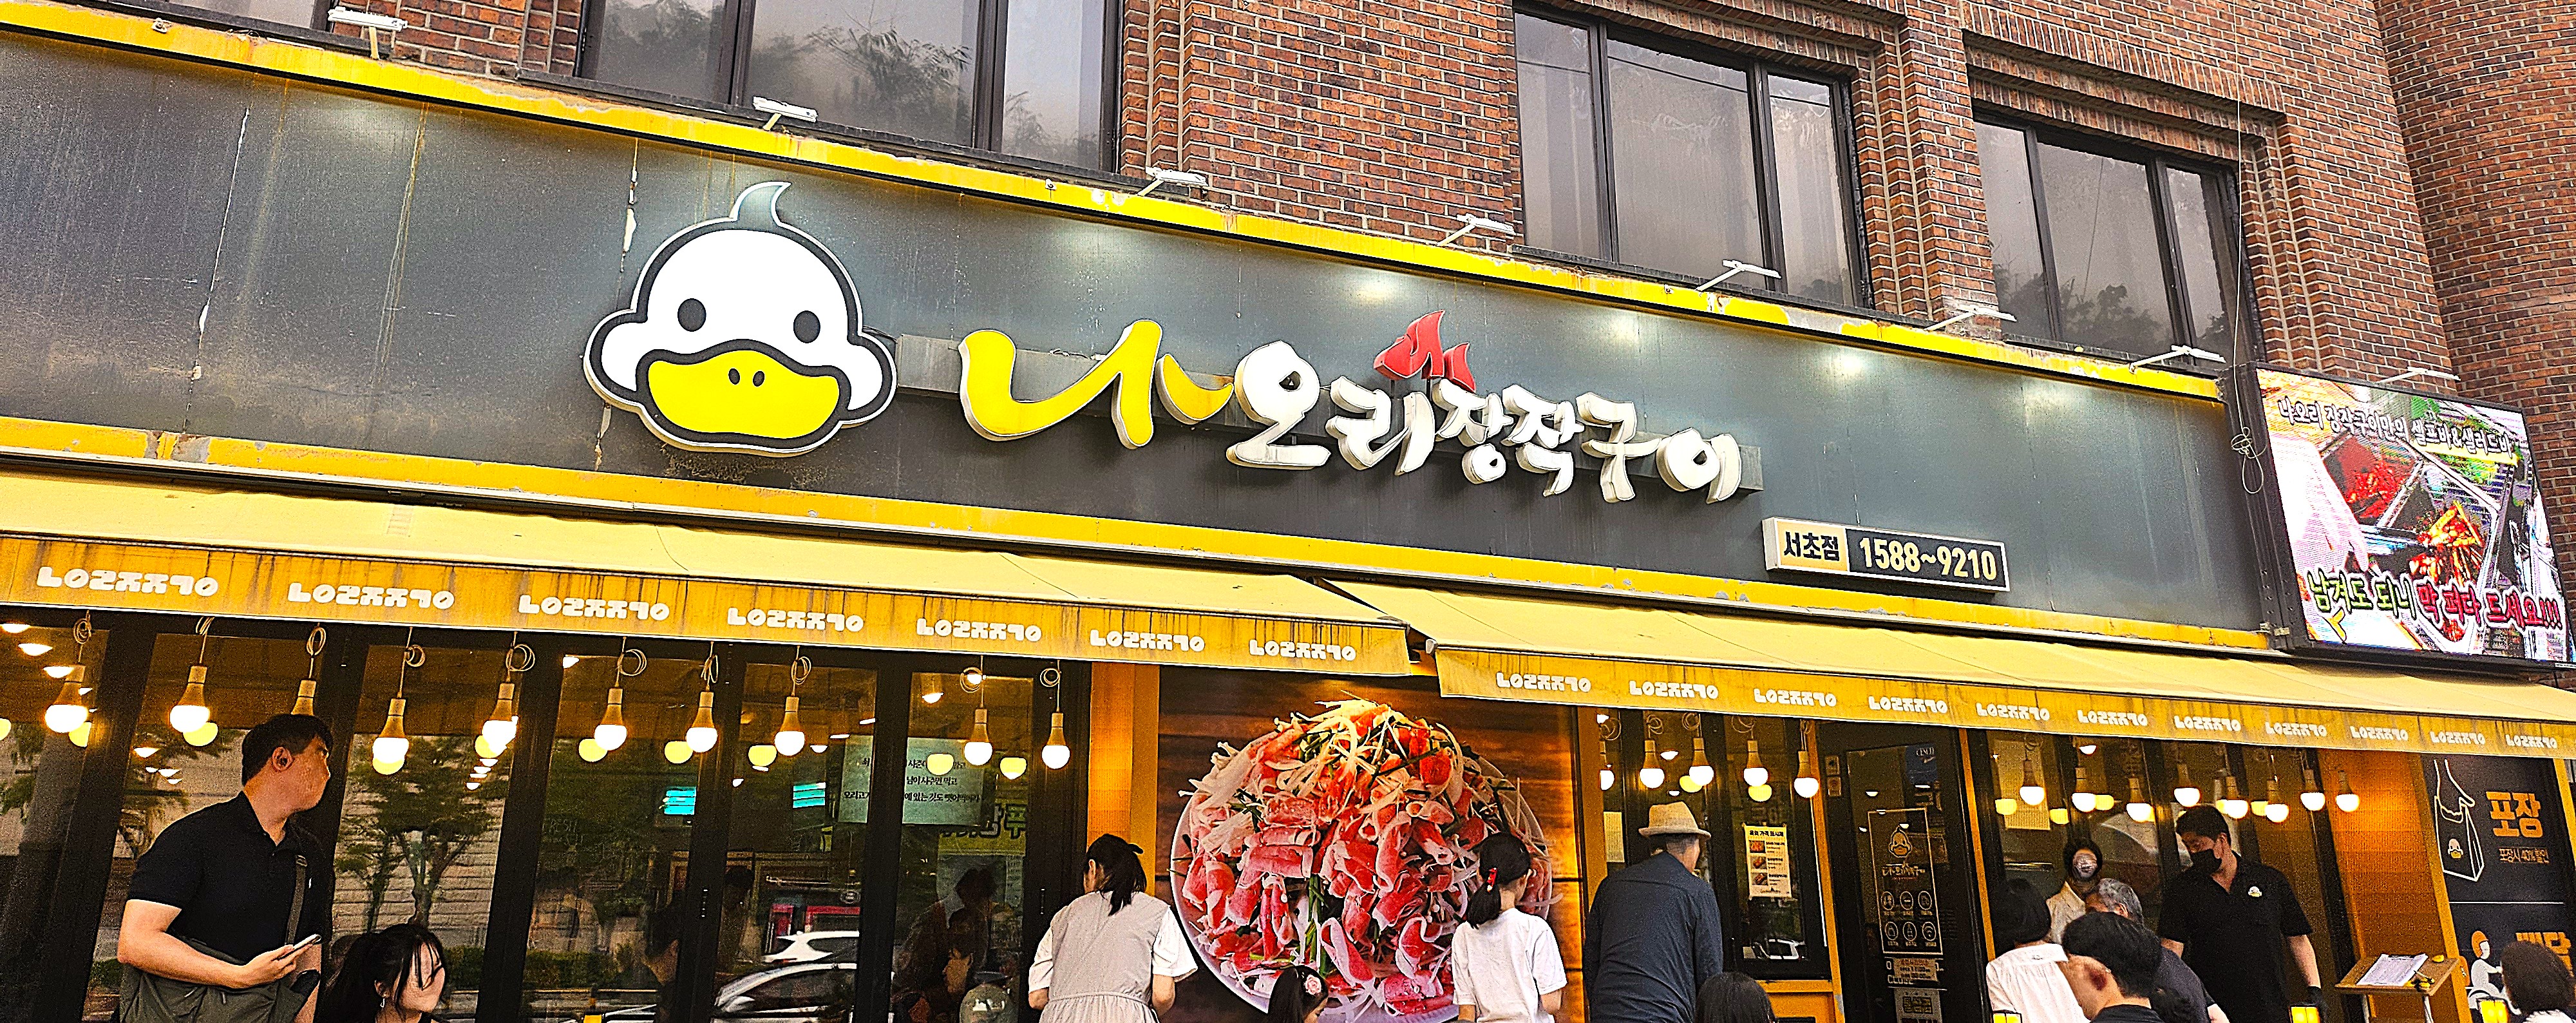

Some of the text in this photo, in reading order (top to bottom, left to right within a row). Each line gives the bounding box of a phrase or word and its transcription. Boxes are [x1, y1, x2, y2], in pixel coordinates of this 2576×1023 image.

[2278, 396, 2324, 430] 나오리
[2325, 405, 2410, 443] 장작구이만의
[1783, 531, 1997, 581] 서초점 1588~9210
[2306, 568, 2563, 630] 남겨도 되니 막 퍼다 드세요!!!
[2486, 791, 2543, 837] 포장
